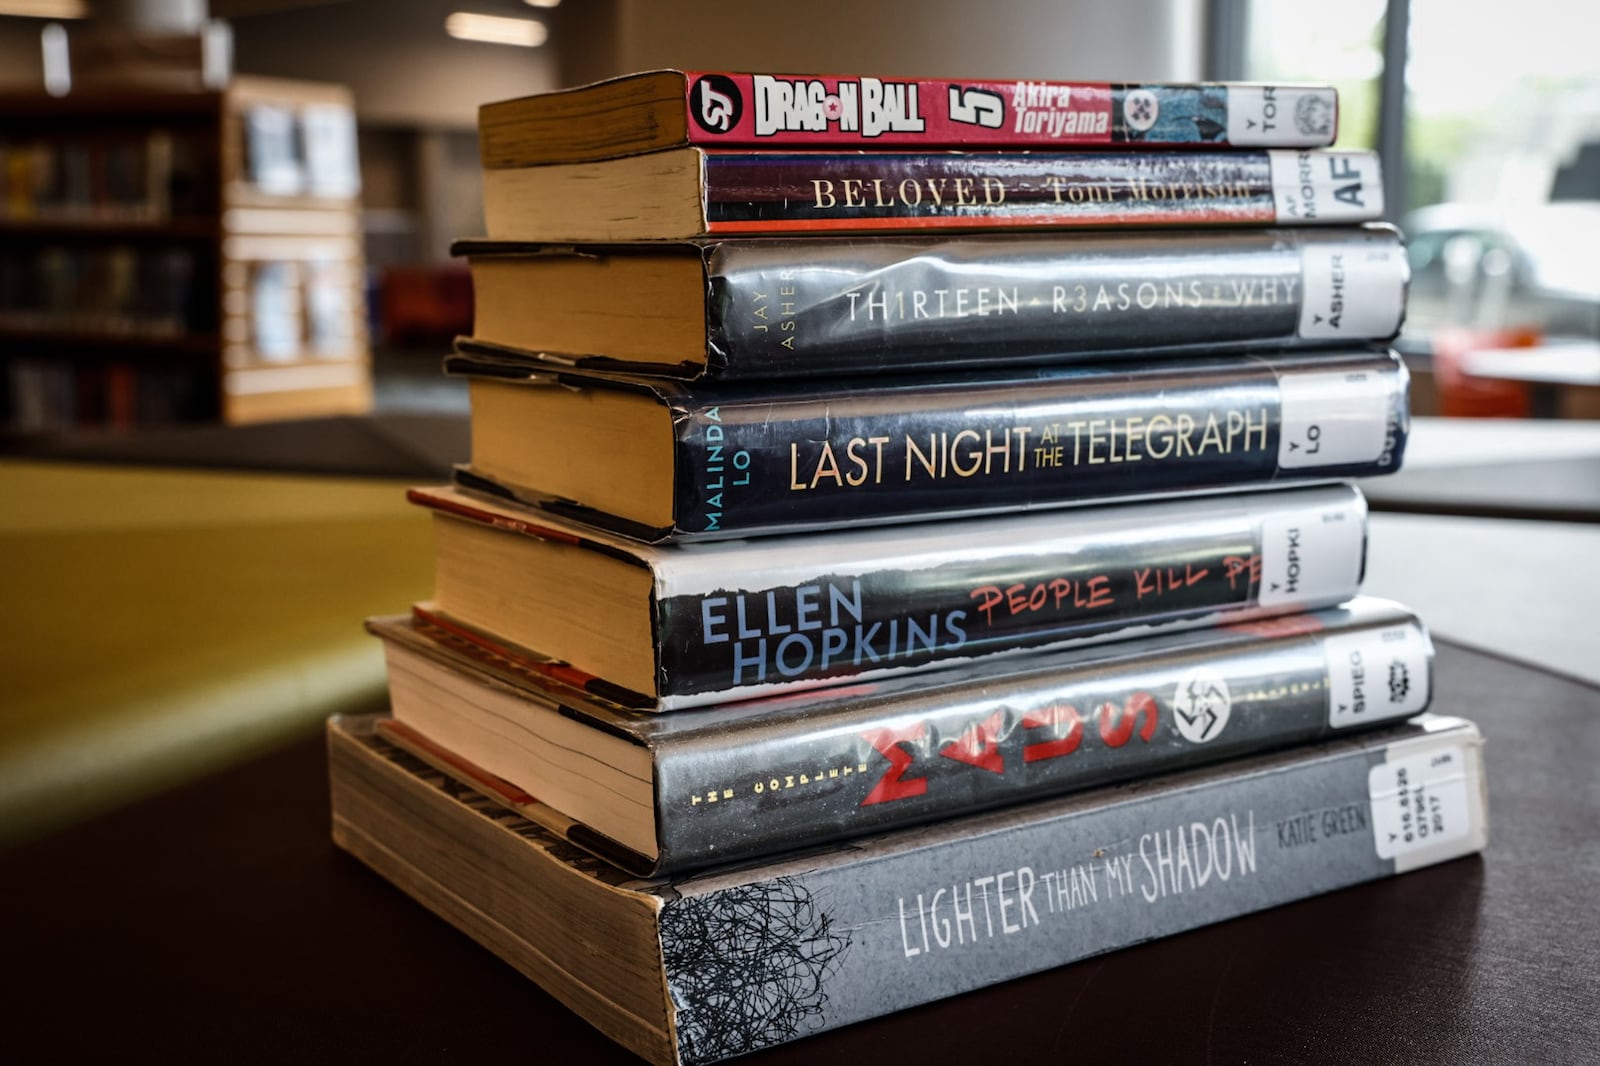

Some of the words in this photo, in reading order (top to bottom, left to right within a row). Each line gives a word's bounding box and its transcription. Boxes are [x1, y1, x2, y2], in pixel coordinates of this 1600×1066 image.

[860, 77, 925, 137] BALL
[949, 85, 1004, 129] 5
[1012, 80, 1070, 107] Akira
[1014, 106, 1109, 135] Toriyama
[1246, 119, 1256, 130] Y
[811, 176, 1006, 209] BELOVED
[1046, 176, 1116, 204] Toni
[1129, 176, 1249, 201] Morrison
[1330, 157, 1365, 208] AF
[754, 291, 768, 333] JAY
[780, 269, 795, 350] ASHER
[1053, 281, 1202, 313] R3ASONS
[1231, 276, 1297, 305] WHY
[1329, 254, 1345, 329] ASHER
[1313, 315, 1323, 325] Y
[905, 427, 1032, 481] NIGHT
[1041, 424, 1059, 445] AT
[1068, 409, 1267, 467] TELEGRAPH
[1289, 442, 1300, 452] Y
[1306, 424, 1321, 454] LO
[704, 406, 724, 532] MALINDA
[733, 450, 751, 486] LO
[790, 437, 890, 491] LAST
[1034, 447, 1063, 468] THE
[1285, 528, 1300, 593] HOPKI
[971, 576, 1116, 626] PEOPLE
[1134, 564, 1208, 598] KILL
[1270, 583, 1280, 593] Y
[701, 580, 862, 644] ELLEN
[733, 610, 967, 684] HOPKINS
[1337, 703, 1348, 715] Y
[691, 787, 734, 806] THE
[754, 763, 868, 794] COMPLETE
[859, 692, 1157, 807] MAUS
[1276, 813, 1318, 849] KATIE
[1322, 804, 1368, 838] GREEN
[1429, 796, 1444, 833] 2017
[1388, 832, 1398, 843] Y
[899, 867, 1040, 958] LIGHTER
[1040, 863, 1098, 913] THAN
[1105, 853, 1133, 898] MY
[1139, 810, 1257, 903] SHADOW
